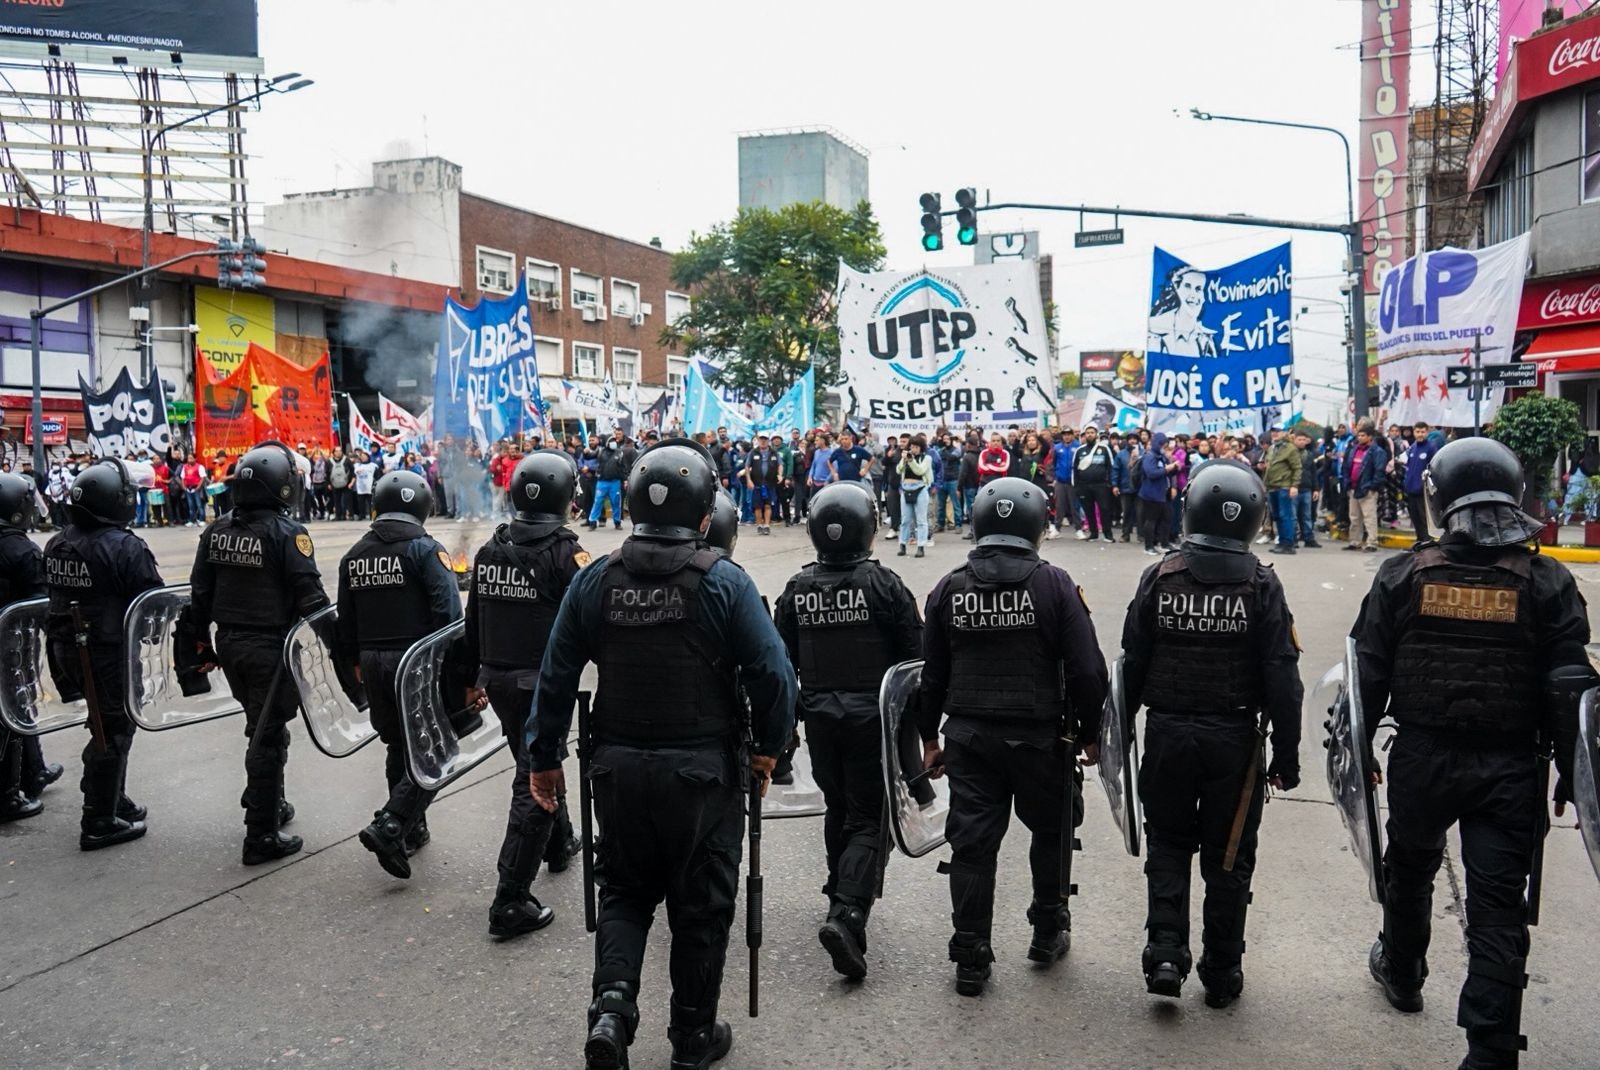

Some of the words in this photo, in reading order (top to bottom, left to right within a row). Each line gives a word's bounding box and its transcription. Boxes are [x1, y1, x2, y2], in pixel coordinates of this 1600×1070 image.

[0, 25, 32, 35] ONDUCIR
[33, 28, 44, 36] NO
[45, 28, 70, 38] TOMES
[1208, 263, 1292, 303] Movimiento
[867, 308, 976, 360] UTEP
[1220, 308, 1291, 357] Evita
[1433, 330, 1448, 341] DEL
[1449, 325, 1495, 339] PUEBLO
[1518, 363, 1535, 371] Juan
[497, 356, 538, 403] SUR
[1146, 365, 1203, 409] JOSÉ
[1212, 373, 1238, 408] C.
[870, 387, 995, 421] ESCOBAR
[873, 422, 918, 430] MOVIMIENTO
[210, 533, 262, 554] POLICIA
[47, 557, 89, 576] POLICIA
[210, 551, 218, 560] DE
[220, 551, 230, 561] LA
[232, 553, 262, 566] CIUDAD
[349, 556, 402, 576] POLICIA
[54, 575, 62, 585] LA
[63, 576, 92, 588] CIUDAD
[350, 577, 359, 587] DE
[360, 577, 370, 586] LA
[372, 574, 403, 585] CIUDAD
[478, 584, 487, 594] DE
[489, 584, 500, 595] LA
[502, 585, 536, 599] CIUDAD
[611, 587, 683, 606] POLICIA
[952, 590, 1034, 614] POLICIA
[1159, 593, 1246, 618] POLICIA
[610, 611, 624, 620] DE
[626, 611, 639, 622] LA
[642, 609, 683, 622] CIUDAD
[797, 614, 809, 625] DE
[812, 613, 825, 624] LA
[828, 609, 869, 623] CIUDAD
[953, 615, 967, 627] DE
[971, 615, 987, 627] LA
[991, 613, 1035, 627] CIUDAD
[1421, 605, 1454, 617] POLICIA
[1458, 609, 1467, 617] DE
[1472, 609, 1482, 620] LA
[1158, 616, 1174, 629] DE
[1178, 617, 1195, 630] LA
[1199, 618, 1247, 632] CIUDAD
